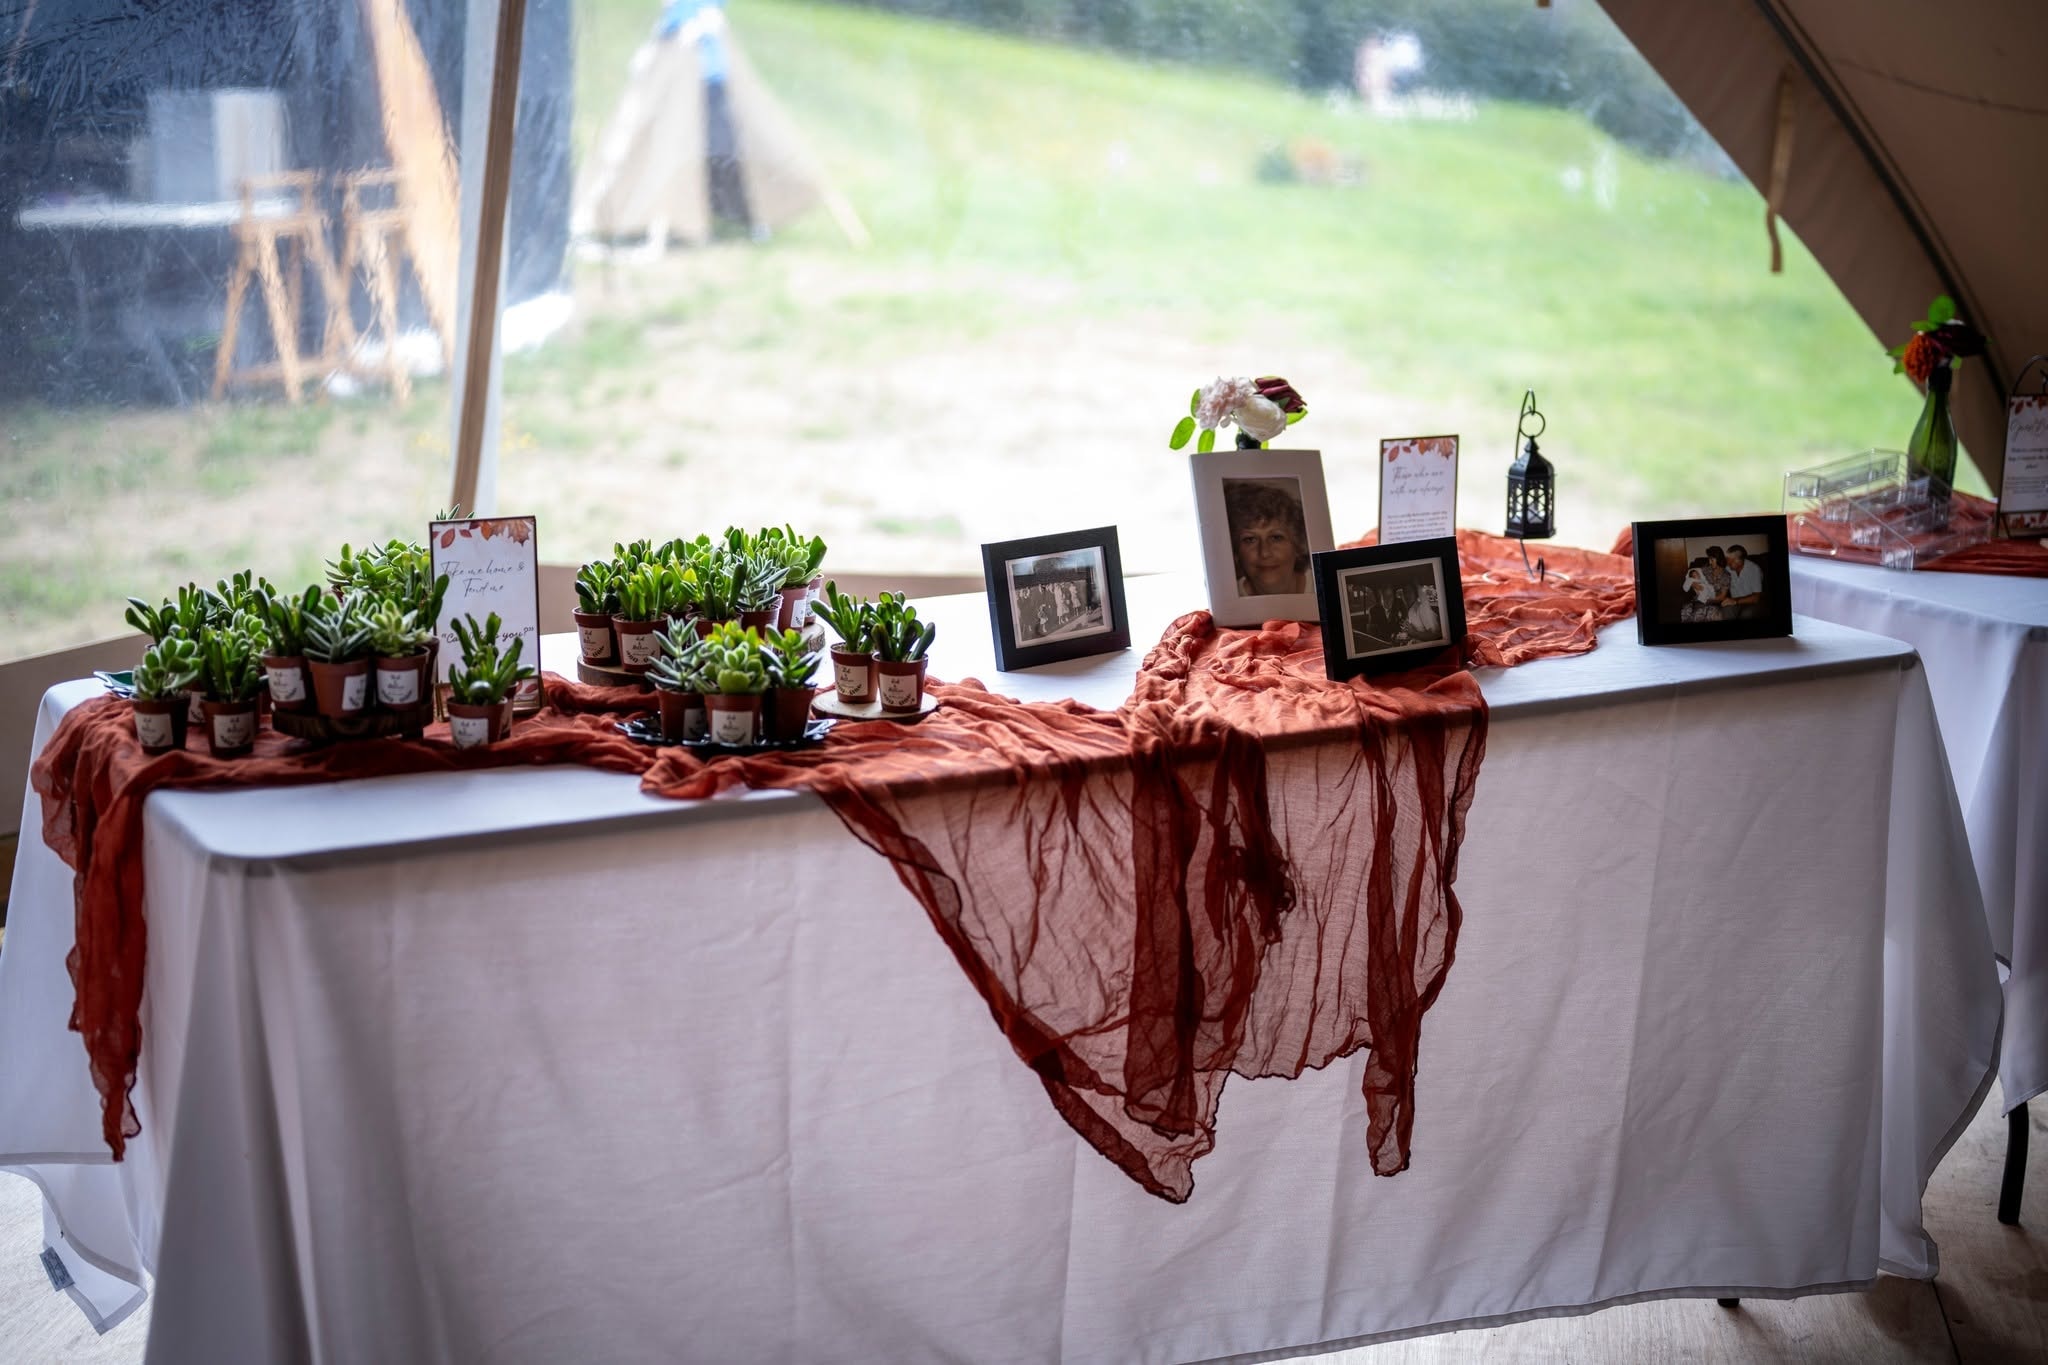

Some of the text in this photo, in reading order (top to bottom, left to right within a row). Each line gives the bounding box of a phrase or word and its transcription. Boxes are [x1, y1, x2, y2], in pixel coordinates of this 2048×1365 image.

[468, 568, 482, 576] me
[486, 559, 512, 575] home
[490, 584, 504, 592] me
